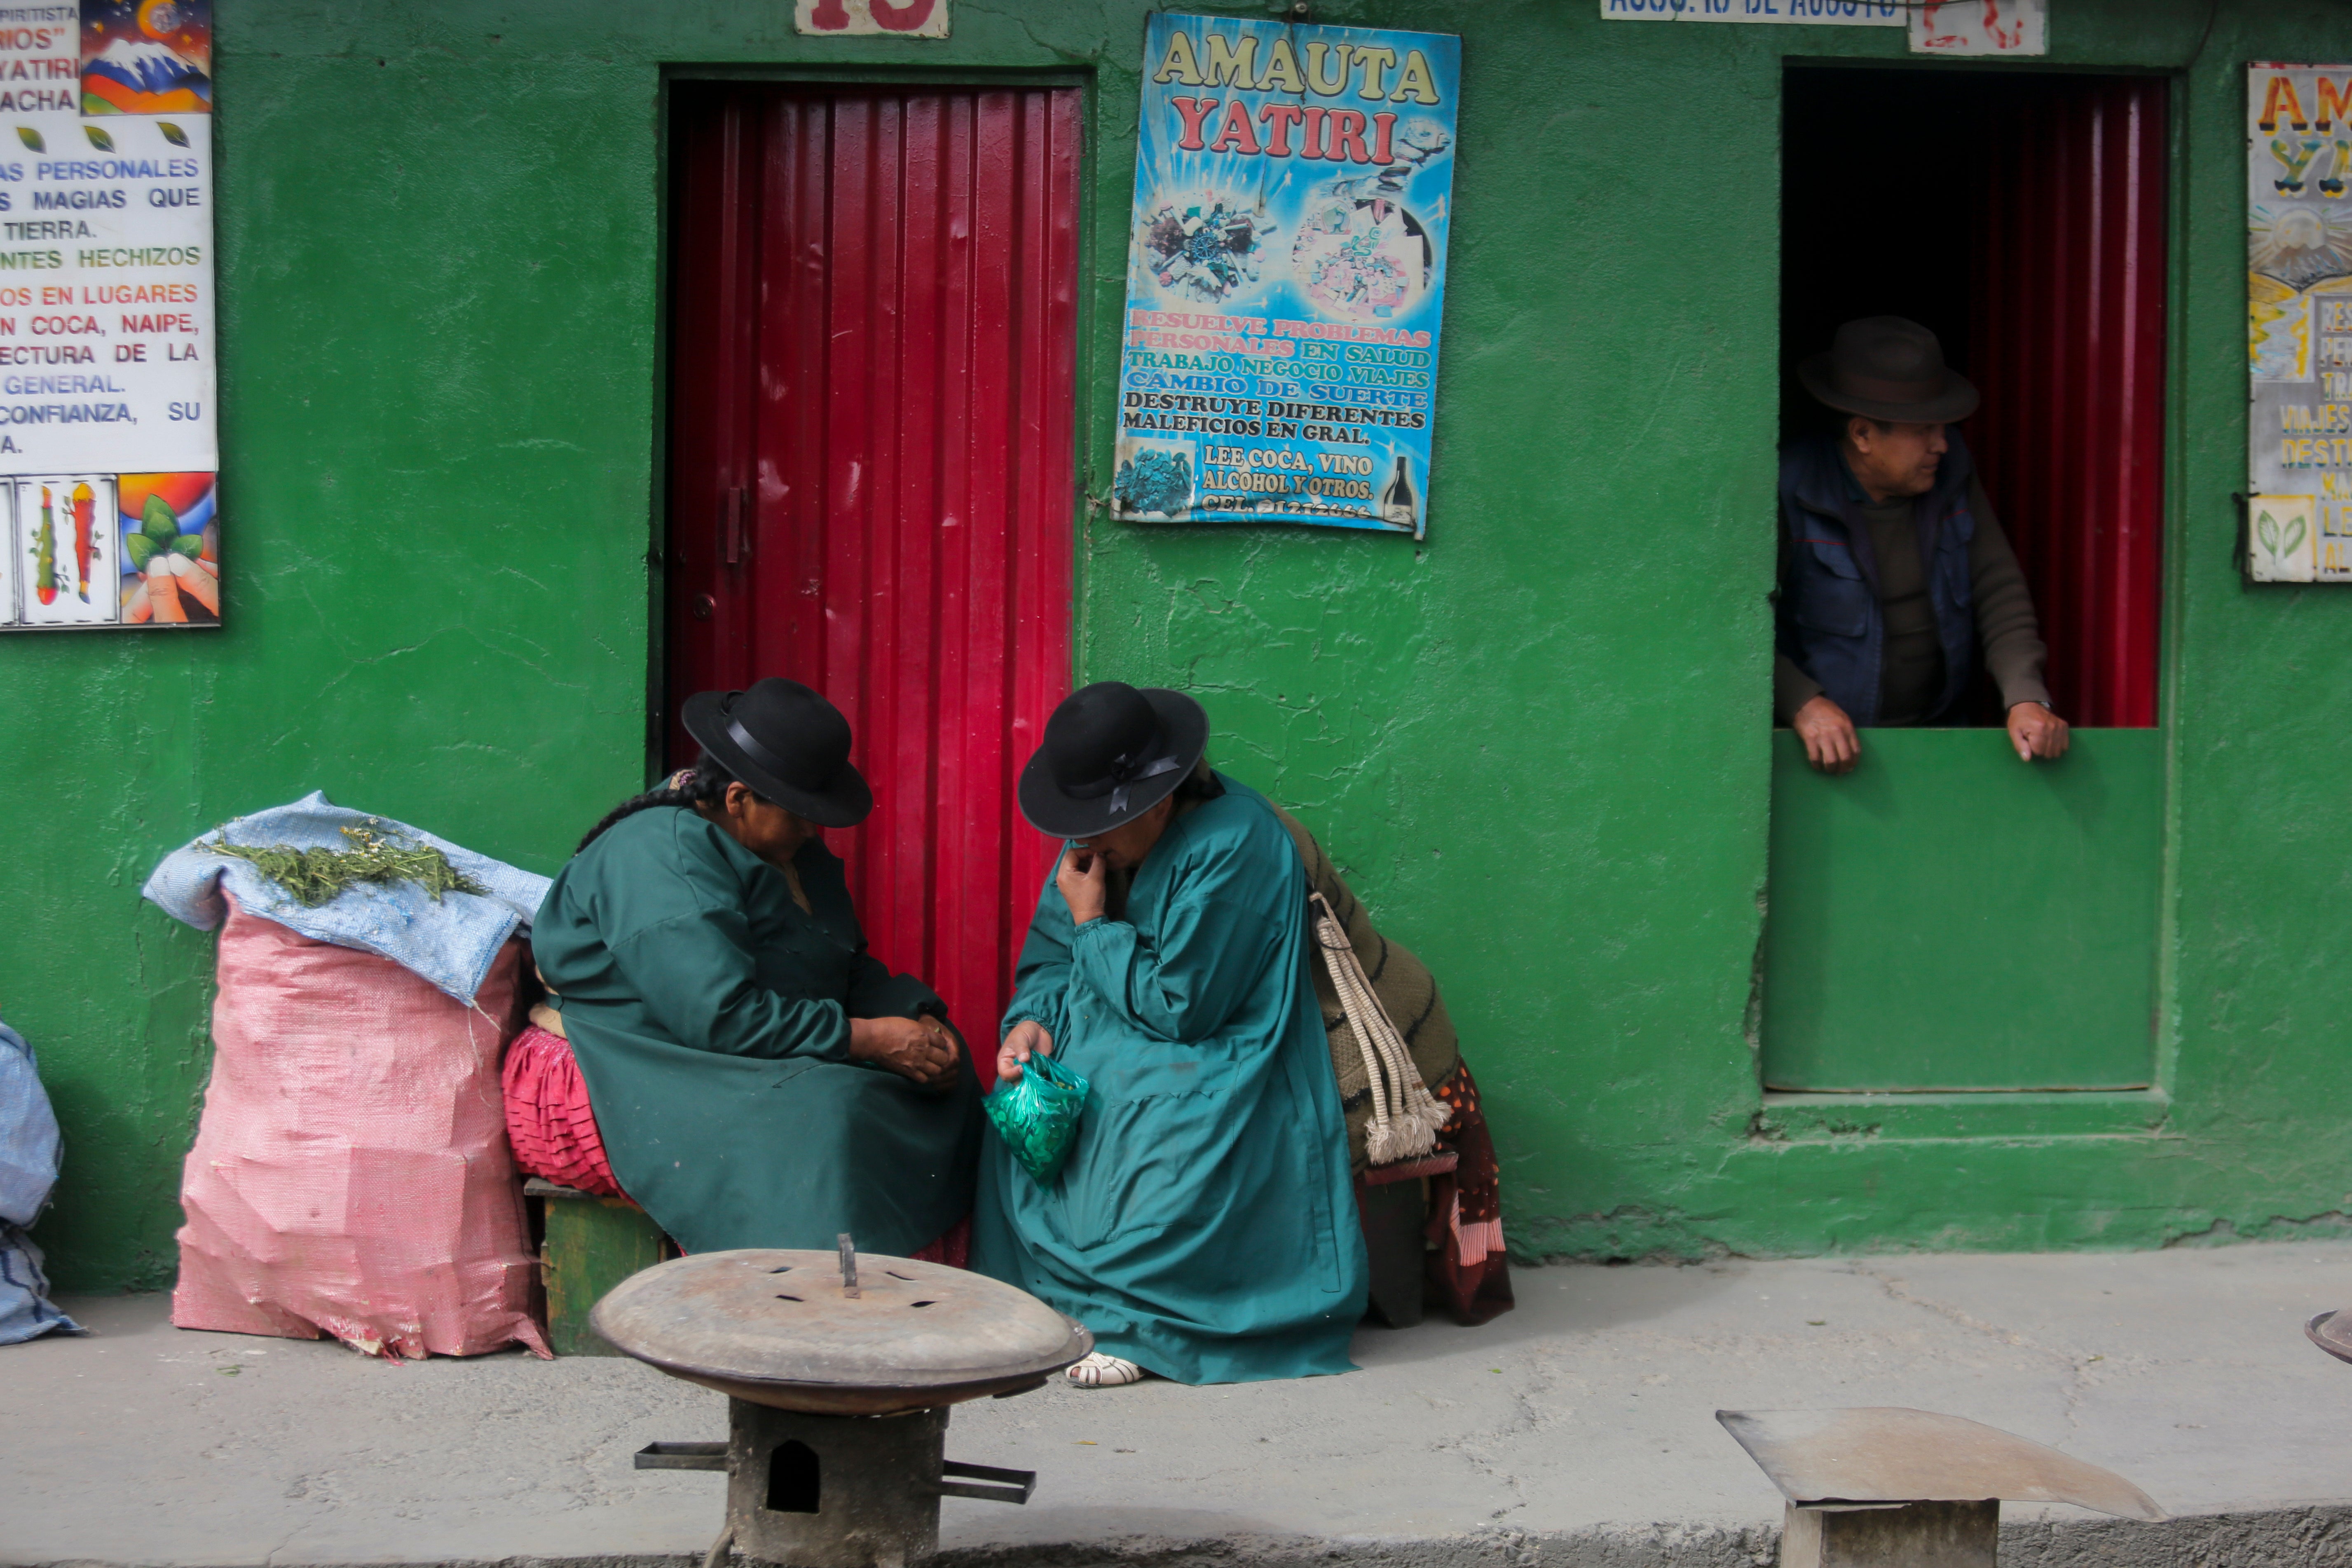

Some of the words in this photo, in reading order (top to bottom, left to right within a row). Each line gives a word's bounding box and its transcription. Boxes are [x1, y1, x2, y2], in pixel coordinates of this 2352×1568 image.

[1154, 31, 1440, 105] AMAUTA
[1171, 96, 1398, 165] YATIRI
[38, 158, 199, 180] PERSONALES
[34, 190, 127, 211] MAGIAS
[149, 187, 201, 208] QUE
[4, 220, 97, 240] TIERRA.
[80, 247, 201, 268] HECHIZOS
[42, 286, 73, 305] EN
[84, 284, 198, 305] LUGARES
[31, 315, 106, 336] COCA,
[122, 313, 199, 336] NAIPE,
[1131, 309, 1267, 335] RESUELVE
[1274, 320, 1431, 347] PROBLEMAS
[116, 344, 147, 363] DE
[169, 343, 199, 361] LA
[1130, 331, 1295, 356] PERSONALES
[1302, 343, 1339, 361] EN
[1346, 346, 1431, 368] SALUD
[1128, 351, 1234, 371] TRABAJO
[1243, 359, 1342, 382] NEGOCIO
[1350, 366, 1430, 388] VIAJES
[5, 375, 126, 396] GENERAL.
[1127, 372, 1248, 394] CAMBIO
[1256, 380, 1300, 398] DE
[1310, 384, 1428, 408] SUERTE
[169, 401, 201, 422] SU
[1125, 392, 1262, 416] DESTRUYE
[1267, 402, 1426, 429] DIFERENTES
[2280, 404, 2350, 435] VIAJES
[1123, 412, 1261, 436] MALEFICIOS
[1266, 422, 1298, 439] EN
[1303, 425, 1370, 445] GRAL.
[1204, 445, 1244, 466] LEE
[1248, 448, 1314, 476] COCA,
[1318, 453, 1373, 476] VINO
[1202, 470, 1290, 494] ALCOHOL
[1293, 475, 1307, 494] Y
[1309, 476, 1374, 501] OTROS.
[1202, 495, 1255, 513] CEL.
